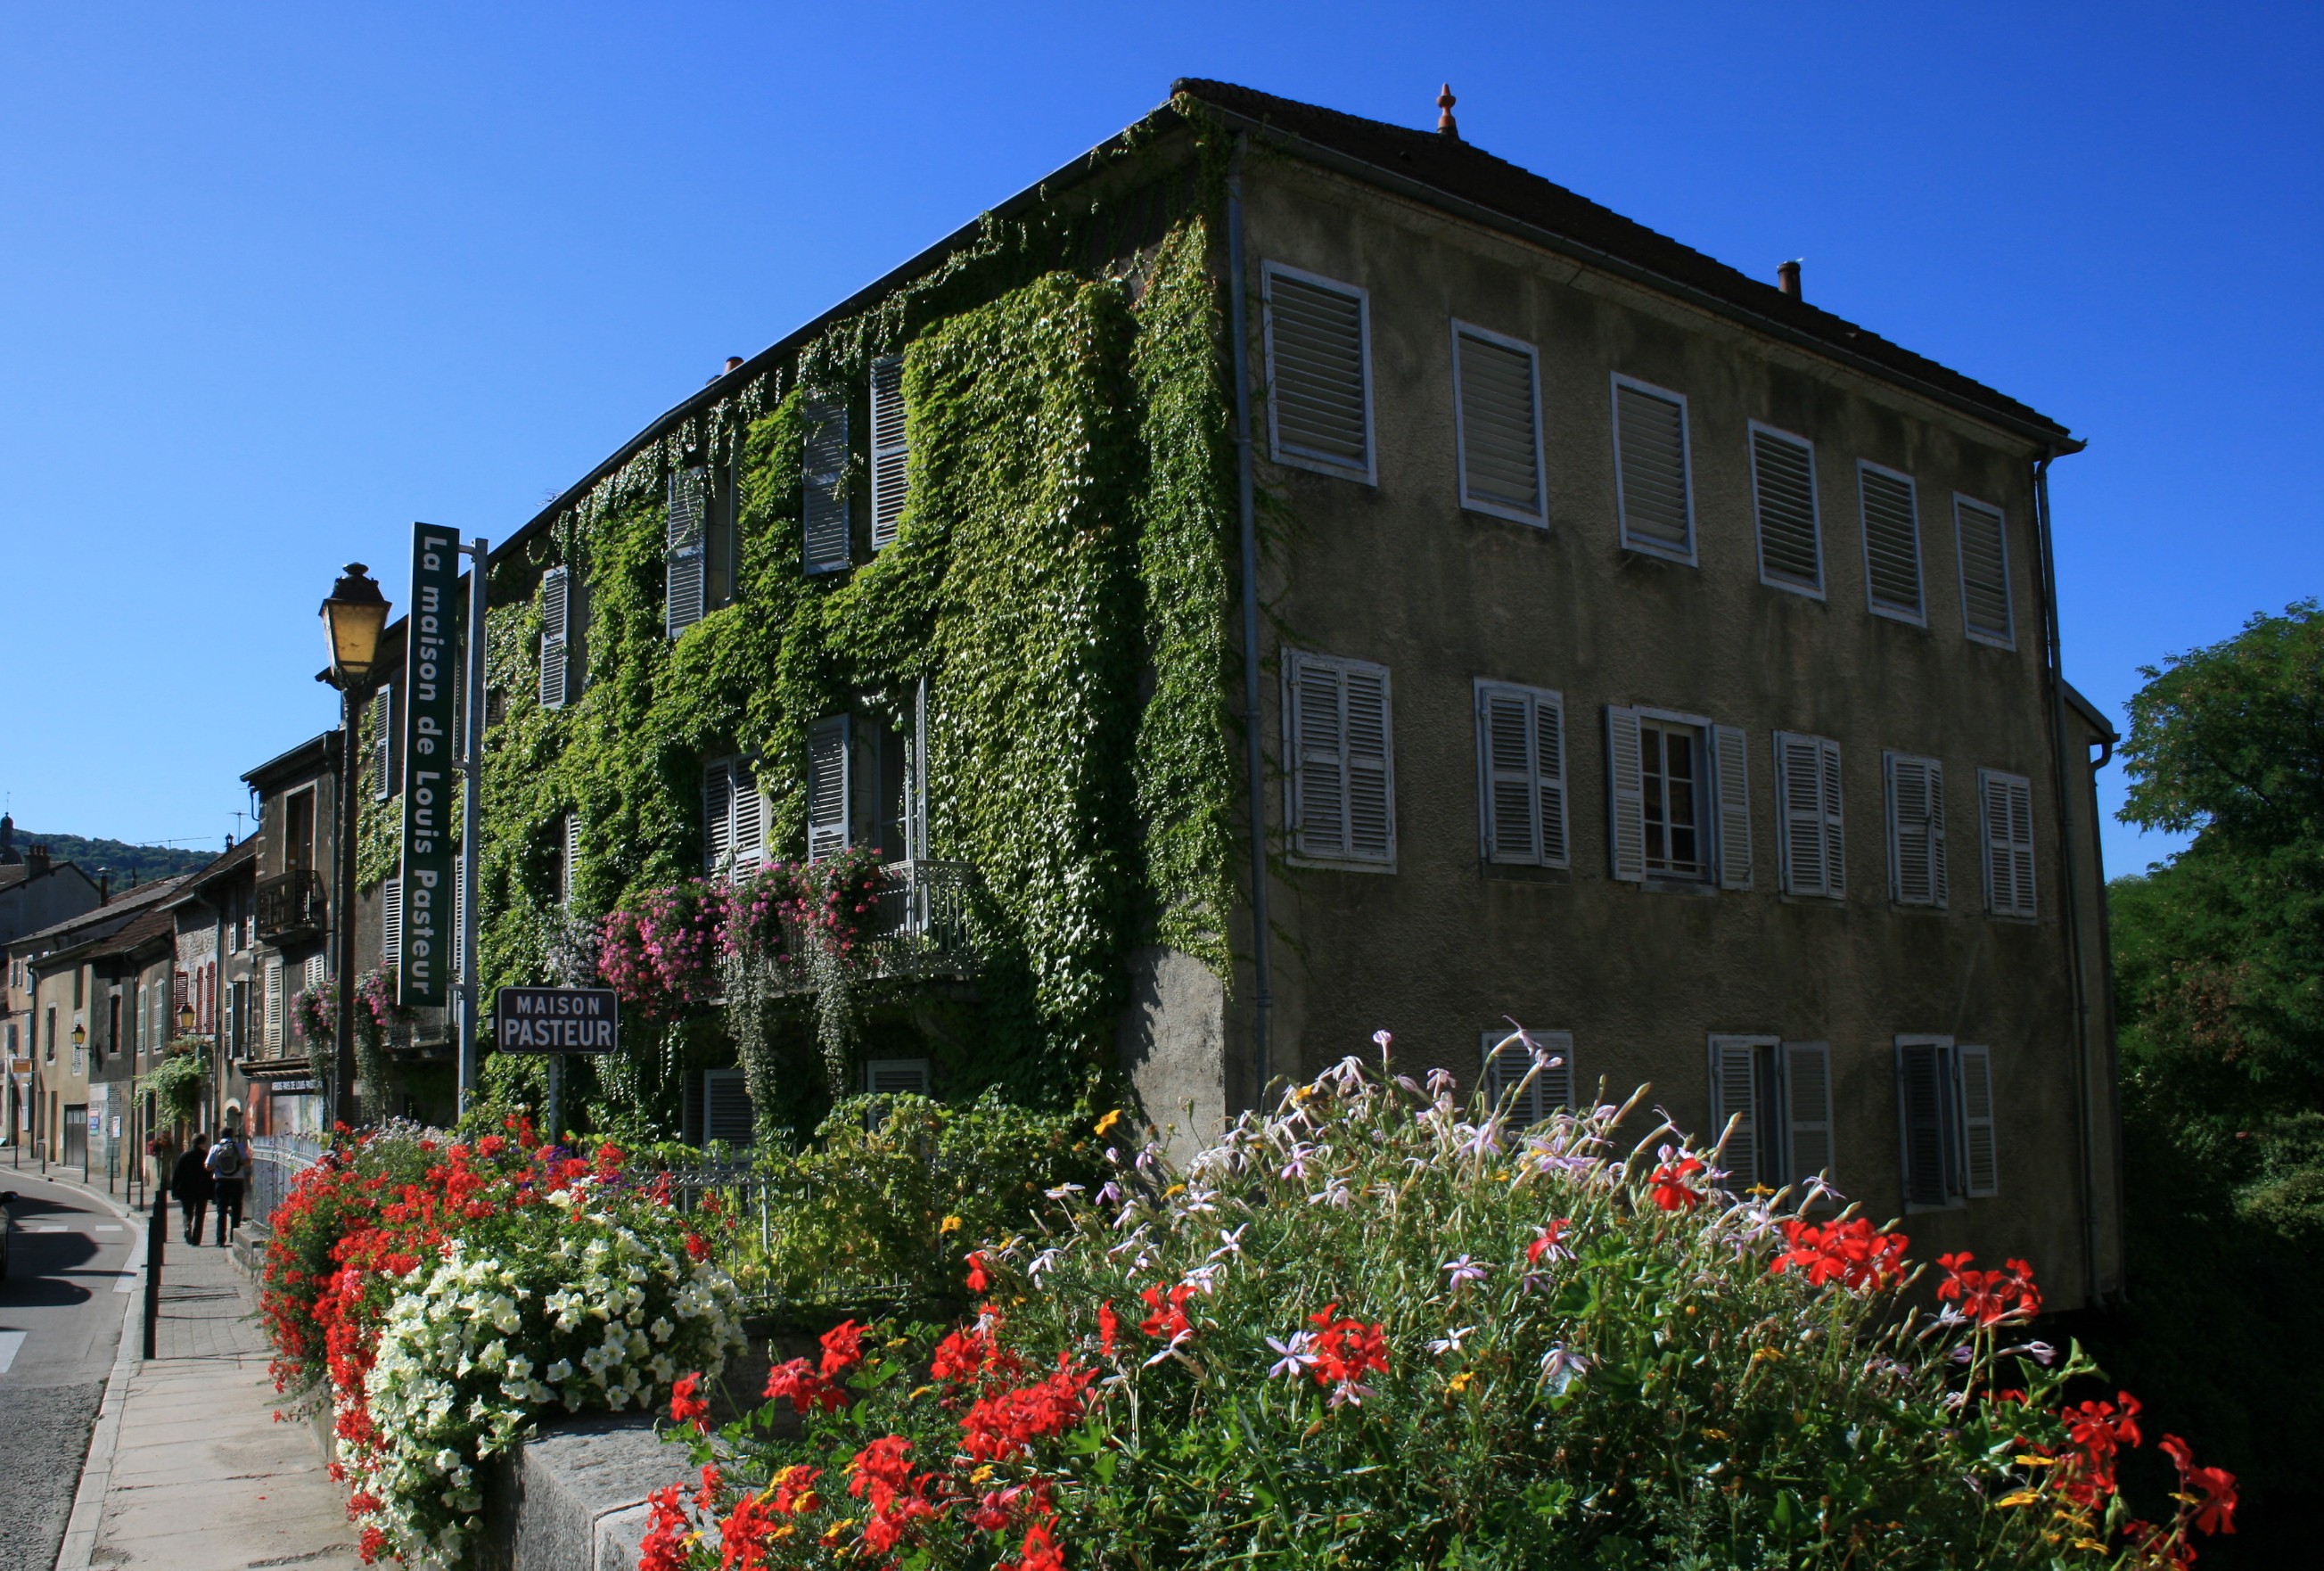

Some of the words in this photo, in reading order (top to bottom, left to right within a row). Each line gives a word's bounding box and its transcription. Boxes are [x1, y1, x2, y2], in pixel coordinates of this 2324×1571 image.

[423, 536, 448, 571] La
[419, 587, 445, 702] maison
[416, 716, 442, 755] de
[415, 770, 440, 853] Louis
[412, 869, 439, 995] Pasteur
[517, 996, 599, 1015] MAISON
[505, 1019, 611, 1047] PASTEUR
